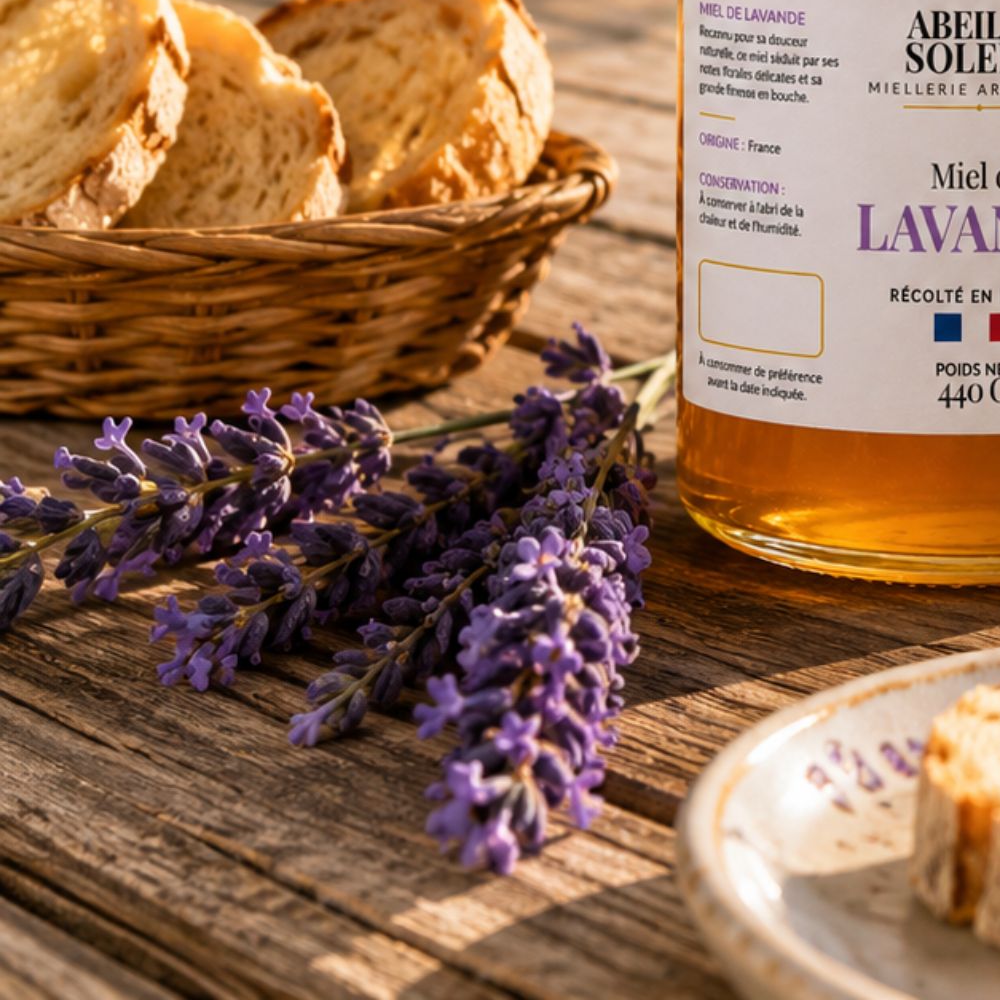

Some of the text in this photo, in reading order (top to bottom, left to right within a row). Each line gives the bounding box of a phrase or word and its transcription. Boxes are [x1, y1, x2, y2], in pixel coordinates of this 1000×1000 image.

[700, 2, 805, 25] MIEL DE LAVANDE
[734, 32, 753, 43] pour
[757, 35, 766, 43] sa
[769, 34, 807, 47] douceur
[737, 52, 746, 61] ce
[750, 51, 767, 62] miel
[803, 56, 819, 67] par
[822, 57, 839, 67] ses
[755, 70, 796, 84] délicates
[798, 74, 808, 84] et
[811, 76, 822, 85] sa
[758, 91, 769, 100] en
[771, 89, 809, 103] bouche.
[868, 82, 967, 96] MIELLERIE
[699, 132, 739, 150] ORIGINE
[748, 140, 781, 154] France
[699, 173, 778, 194] CONSERVATION
[931, 161, 987, 189] Miel
[706, 197, 746, 212] conserver
[749, 201, 754, 213] à
[756, 202, 777, 214] l'abri
[780, 205, 793, 217] de
[796, 205, 803, 217] la
[729, 218, 737, 229] et
[739, 219, 750, 231] de
[752, 220, 801, 237] l'humidité.
[890, 285, 963, 304] RÉCOLTÉ
[971, 289, 992, 303] EN
[754, 366, 766, 377] de
[769, 368, 823, 384] préférence
[936, 362, 980, 376] POIDS
[731, 380, 738, 391] la
[740, 381, 759, 395] date
[762, 384, 807, 401] indiquée.
[938, 382, 983, 408] 440
